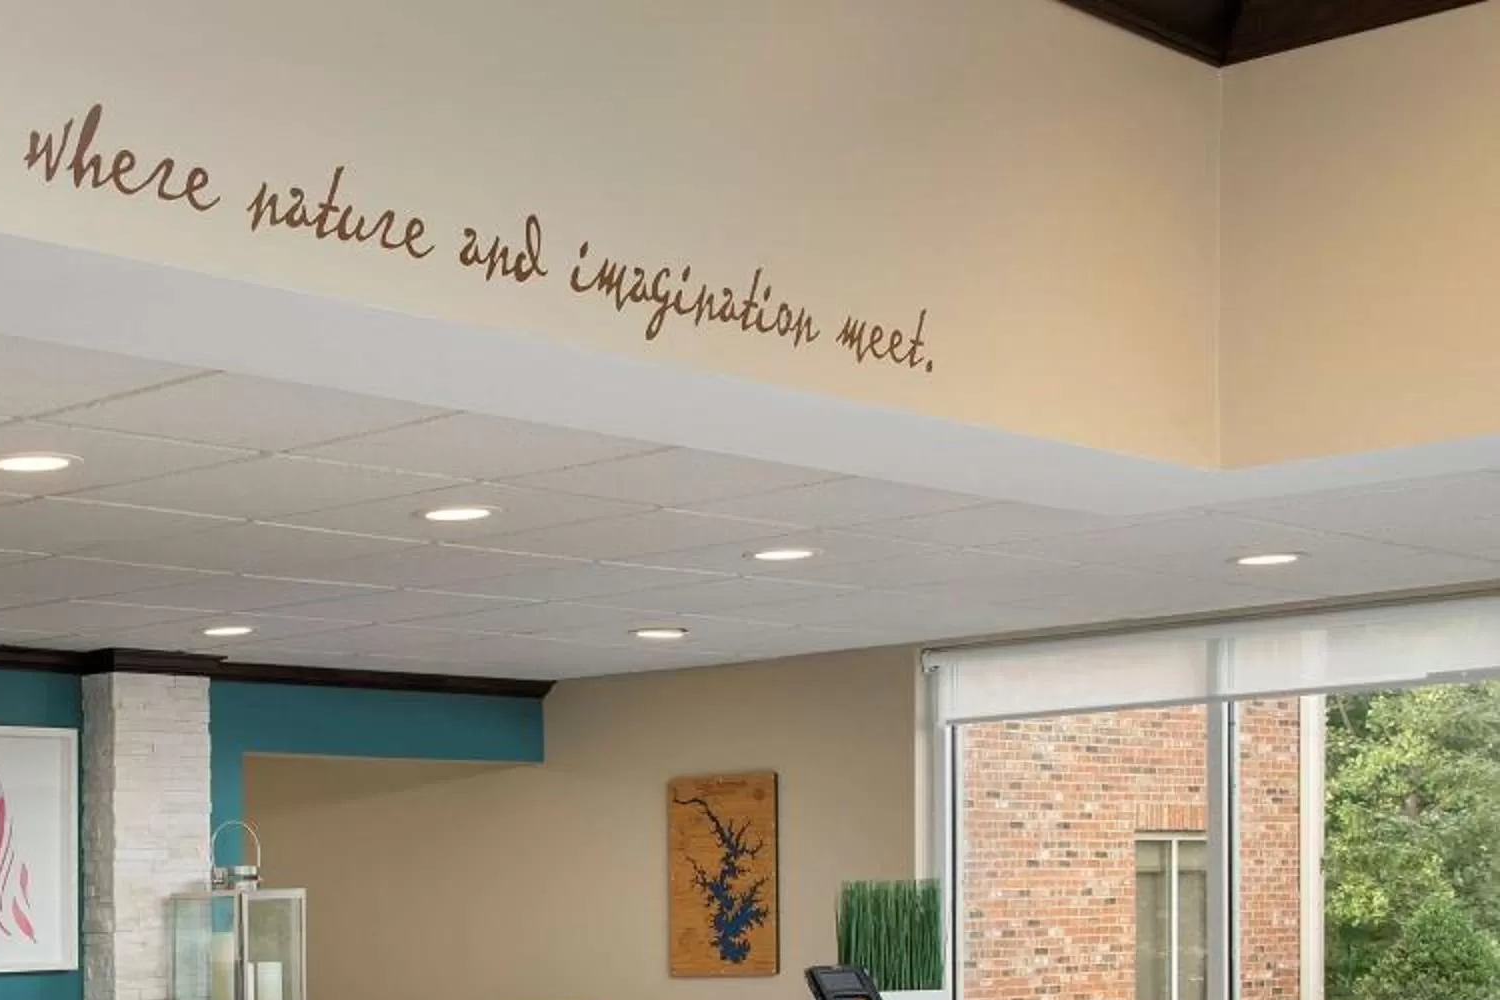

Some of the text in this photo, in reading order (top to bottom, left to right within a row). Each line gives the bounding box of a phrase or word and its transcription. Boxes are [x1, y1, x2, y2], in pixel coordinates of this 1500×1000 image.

[24, 103, 221, 212] where
[246, 165, 436, 259] nature
[460, 213, 549, 283] and
[569, 240, 821, 349] imagination
[835, 308, 934, 374] meet.
